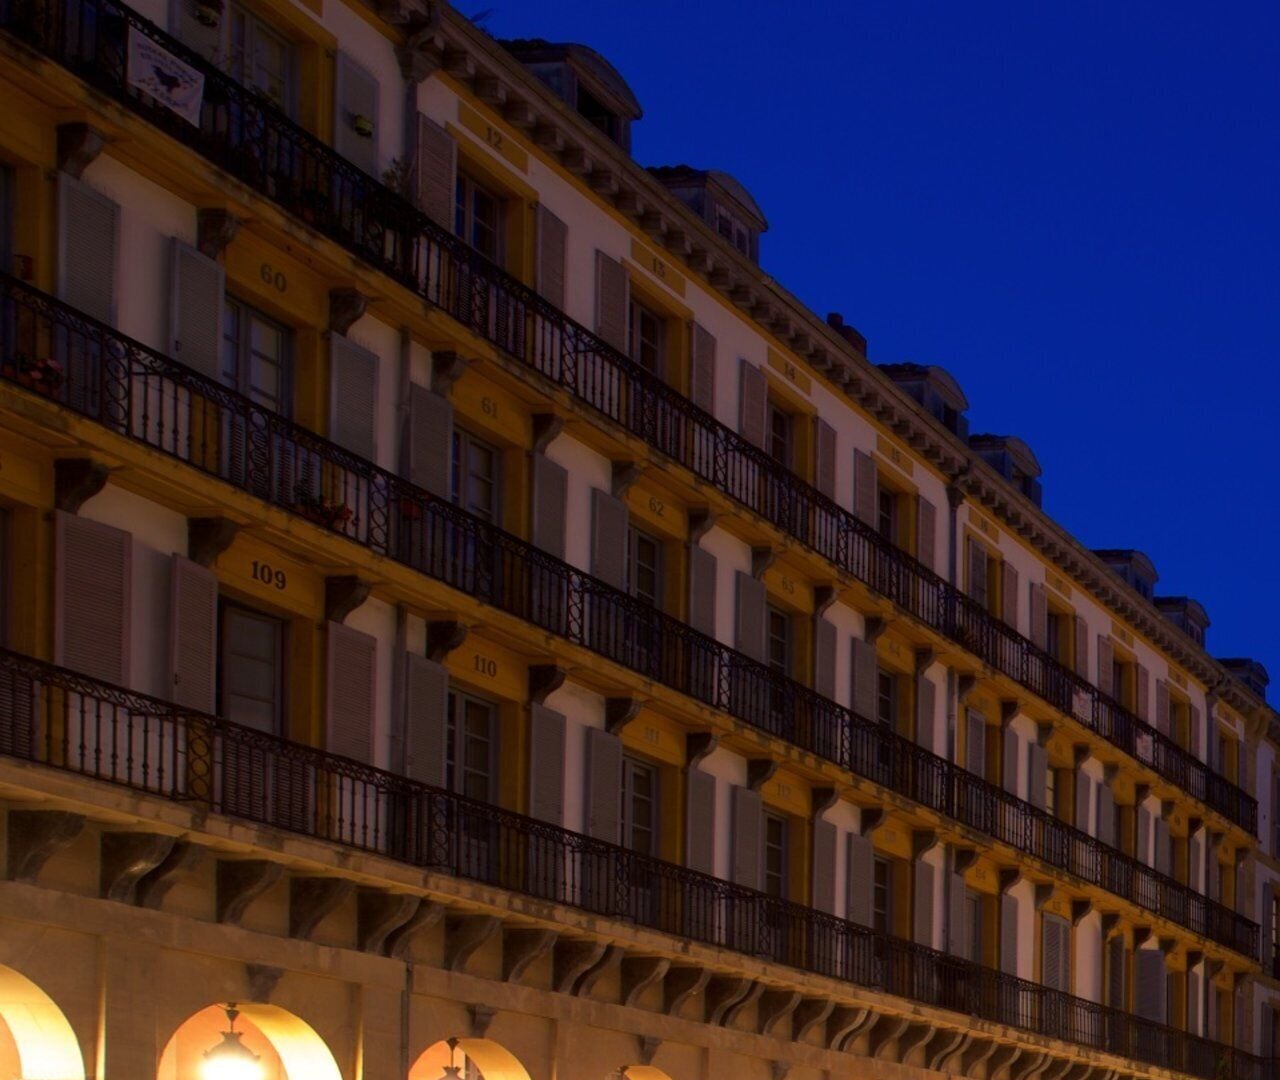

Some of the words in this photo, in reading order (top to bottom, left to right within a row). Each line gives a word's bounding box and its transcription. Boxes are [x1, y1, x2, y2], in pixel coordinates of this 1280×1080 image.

[487, 127, 502, 150] 12
[260, 263, 287, 293] 60
[653, 258, 665, 278] 13
[481, 396, 498, 419] 61
[649, 496, 664, 517] 62
[252, 560, 286, 590] 109
[473, 654, 497, 678] 110
